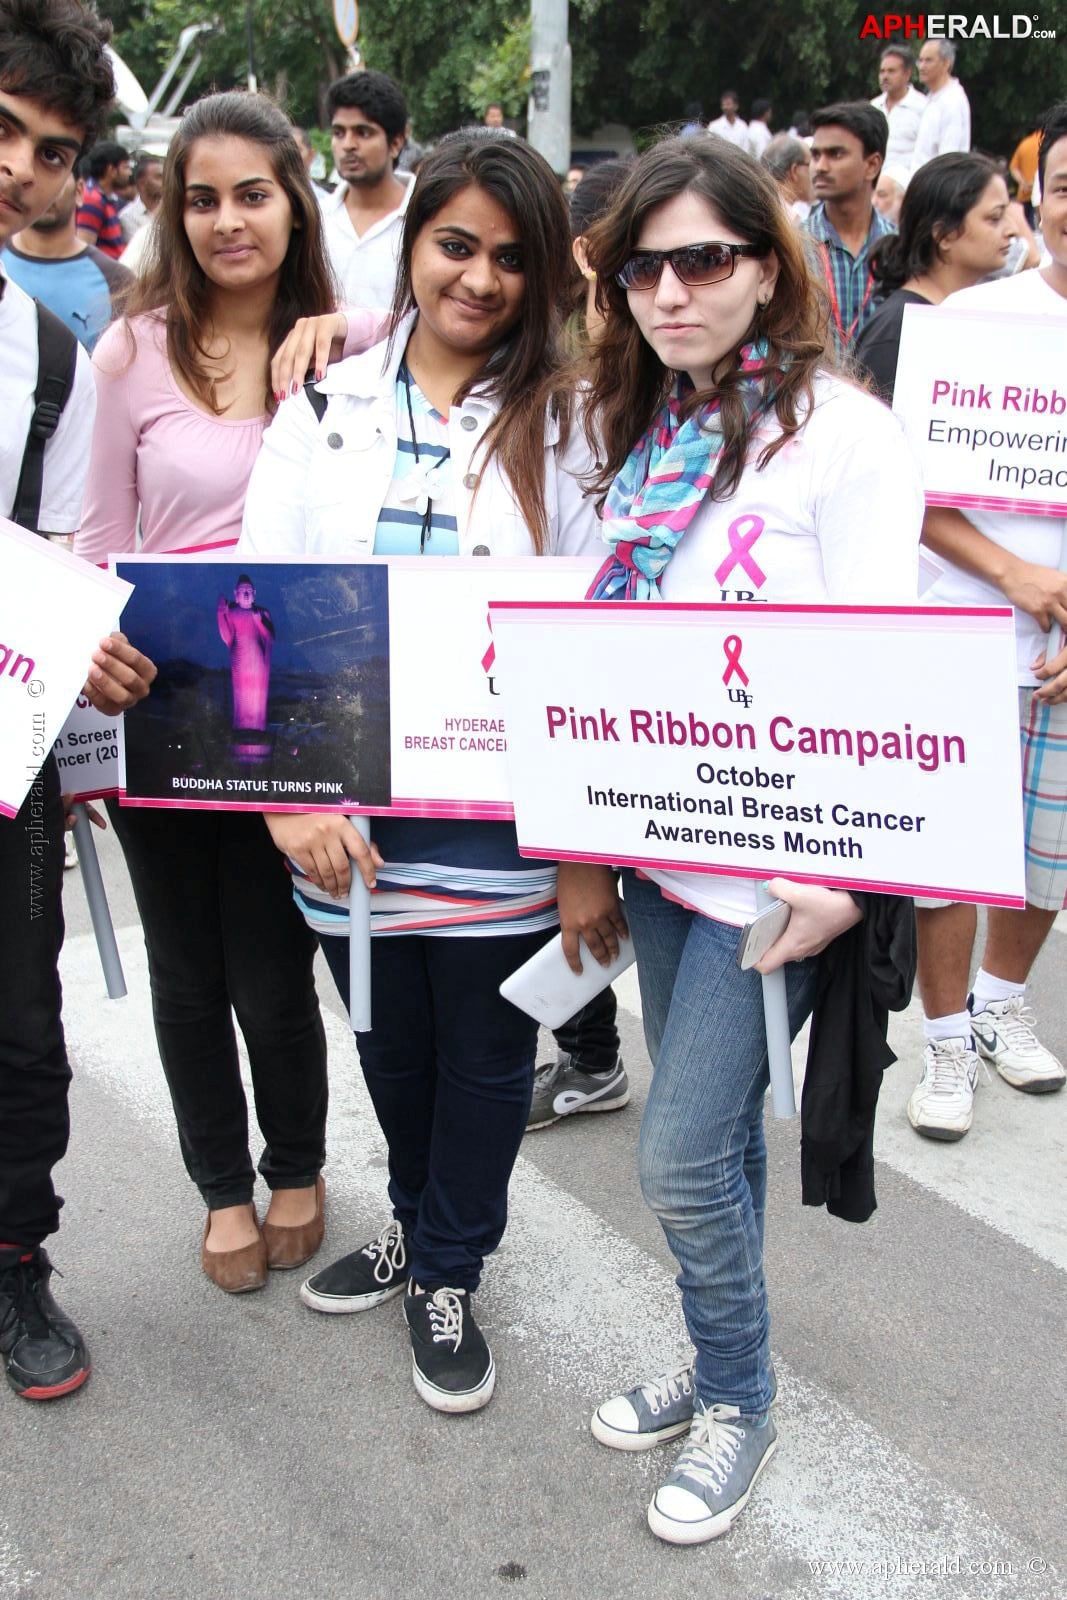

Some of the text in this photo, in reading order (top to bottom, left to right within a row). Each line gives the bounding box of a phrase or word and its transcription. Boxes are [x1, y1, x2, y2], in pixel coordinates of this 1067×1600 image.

[932, 379, 1067, 415] Pink Ribb
[727, 688, 753, 708] UBF
[404, 736, 507, 752] BREAST CANCE
[546, 705, 966, 772] Pink Ribbon Campaign
[172, 777, 343, 794] BUDDHA STATUE TURNS PINK
[696, 762, 795, 789] October
[587, 785, 925, 832] International Breast Cancer
[645, 819, 863, 859] Awareness Month
